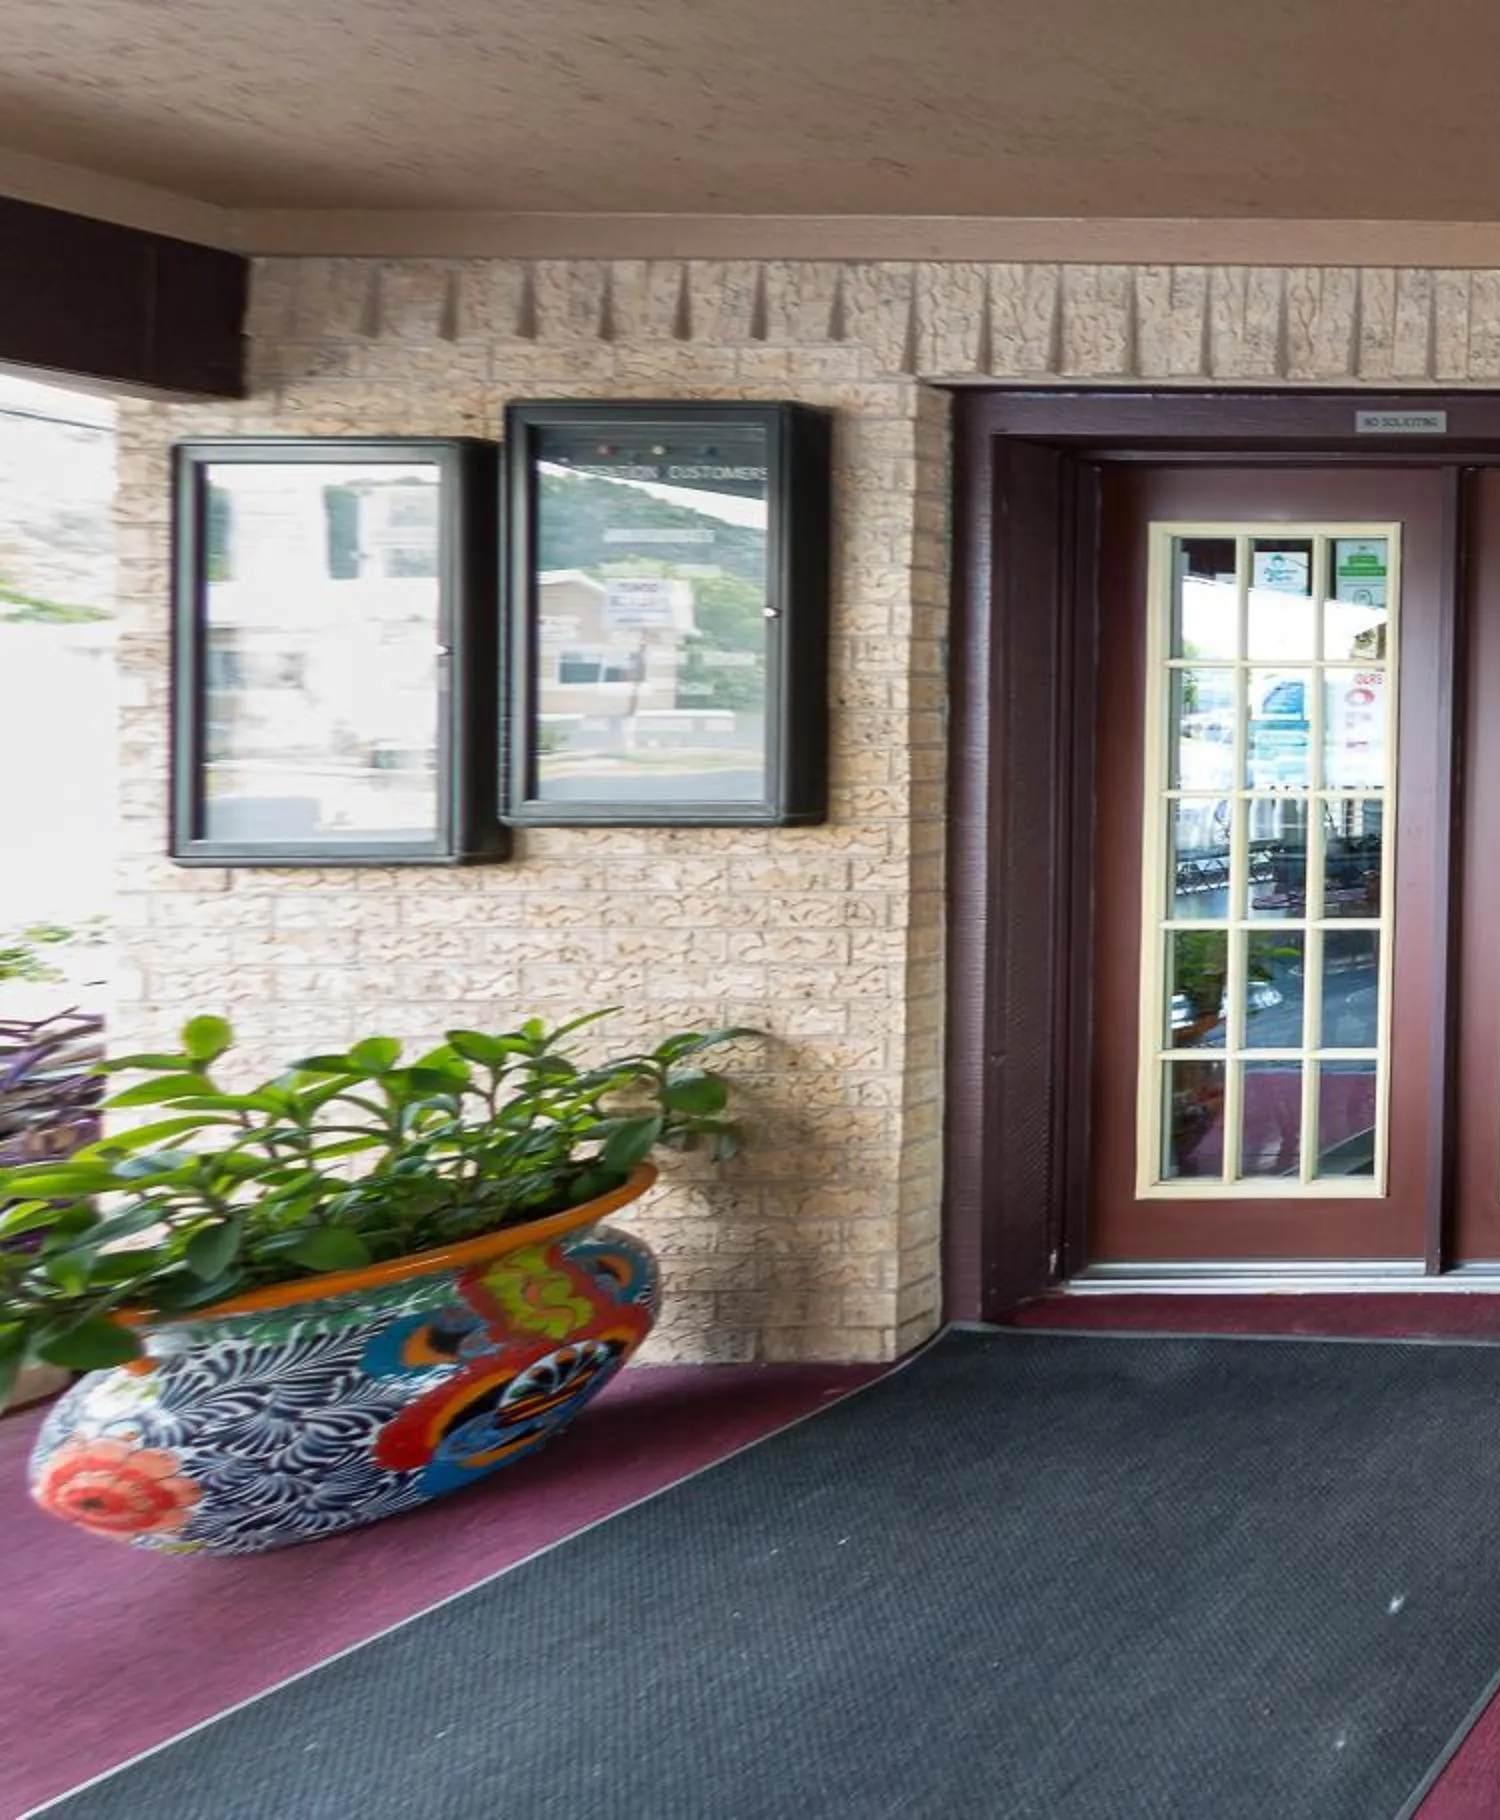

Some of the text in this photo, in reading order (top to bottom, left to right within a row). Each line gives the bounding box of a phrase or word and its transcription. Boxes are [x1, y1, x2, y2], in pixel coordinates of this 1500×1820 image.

[1364, 416, 1439, 428] NO SOLICITING
[668, 465, 768, 481] CUSTOMERS
